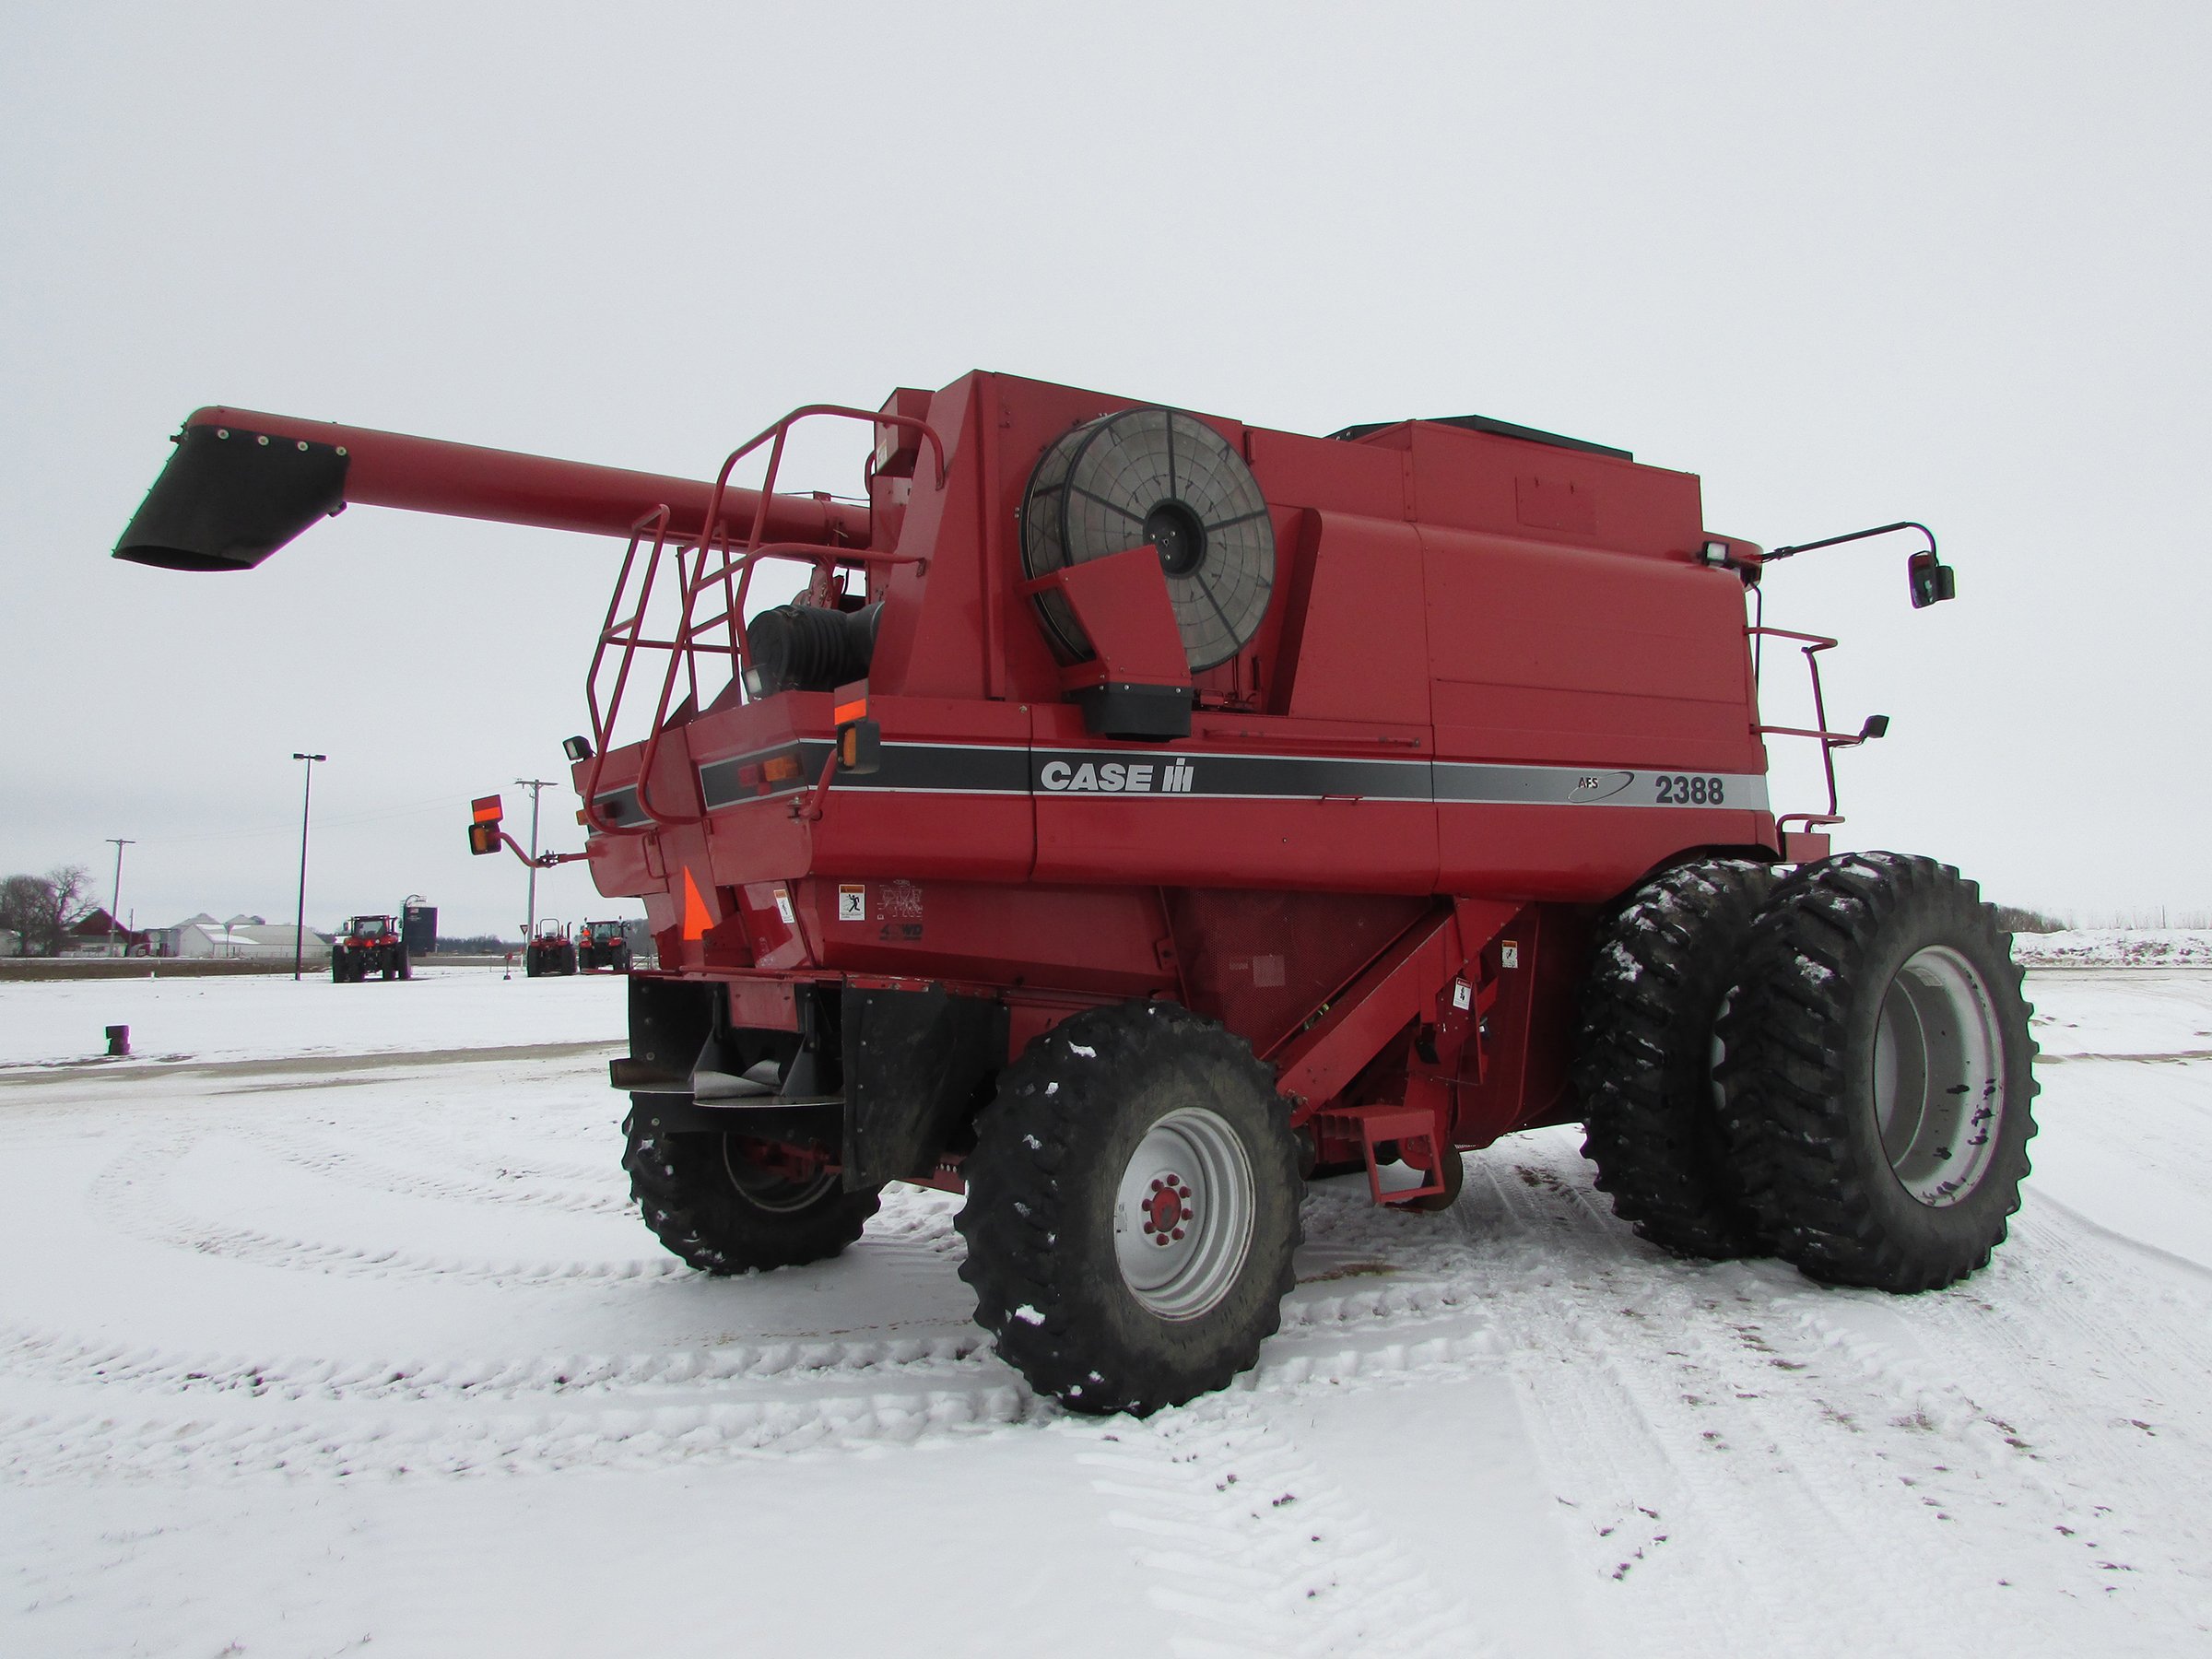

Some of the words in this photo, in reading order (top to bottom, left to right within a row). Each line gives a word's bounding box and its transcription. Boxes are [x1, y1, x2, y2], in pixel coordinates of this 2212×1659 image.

[1041, 760, 1154, 792] CASE
[1578, 776, 1598, 789] AFS
[1655, 775, 1724, 805] 2388
